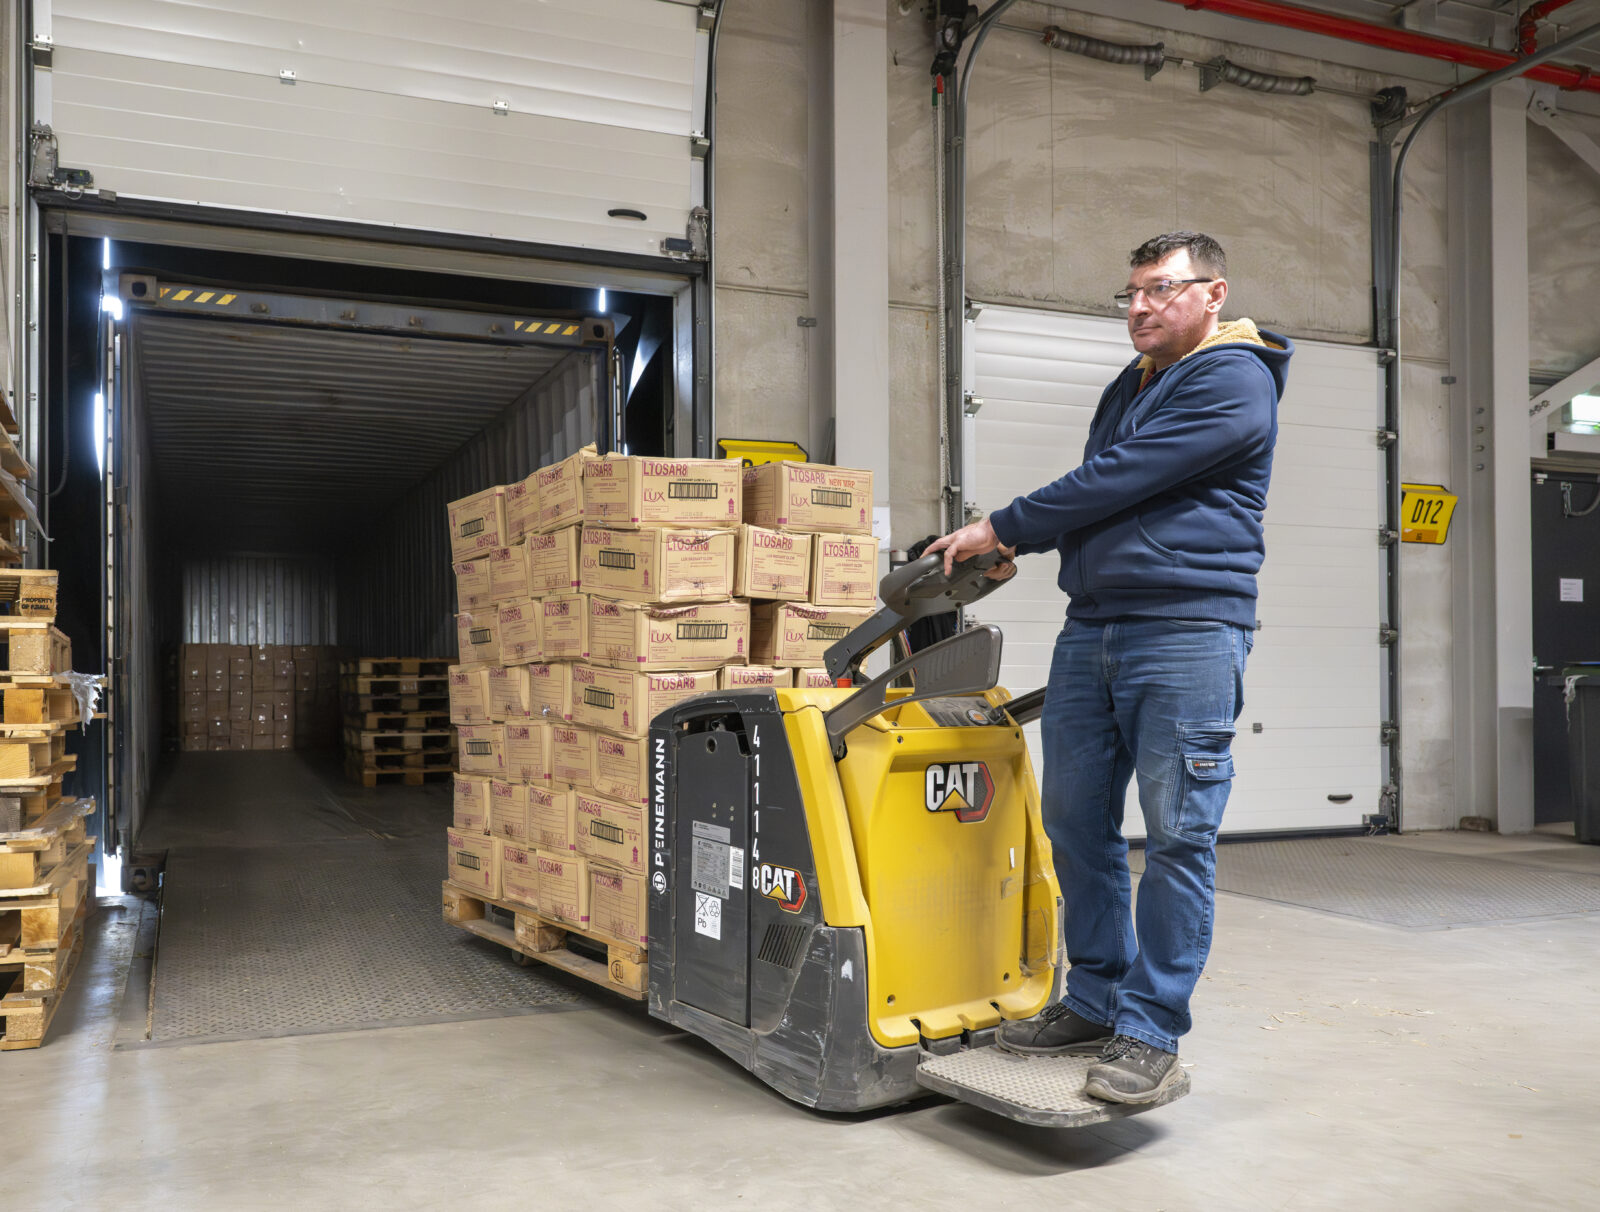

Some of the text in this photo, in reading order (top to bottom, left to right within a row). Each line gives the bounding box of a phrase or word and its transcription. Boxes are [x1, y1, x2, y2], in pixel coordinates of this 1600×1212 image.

[643, 461, 688, 477] LTOSAR8
[789, 469, 826, 485] LTOSAR8
[643, 490, 666, 503] LUX
[791, 495, 810, 508] LUX
[1411, 499, 1444, 524] D12
[583, 528, 611, 545] LTOSAR8
[754, 532, 793, 550] LTOSAR8
[824, 543, 859, 558] LTOSAR8
[583, 556, 598, 569] LUX
[651, 632, 673, 643] LUX
[786, 631, 804, 643] LUX
[650, 675, 695, 691] LTOSAR8
[926, 763, 979, 811] CAT
[655, 738, 665, 867] PEINEMANN
[538, 857, 563, 876] LTOSAR8
[761, 864, 795, 901] CAT
[697, 917, 707, 928] Pb
